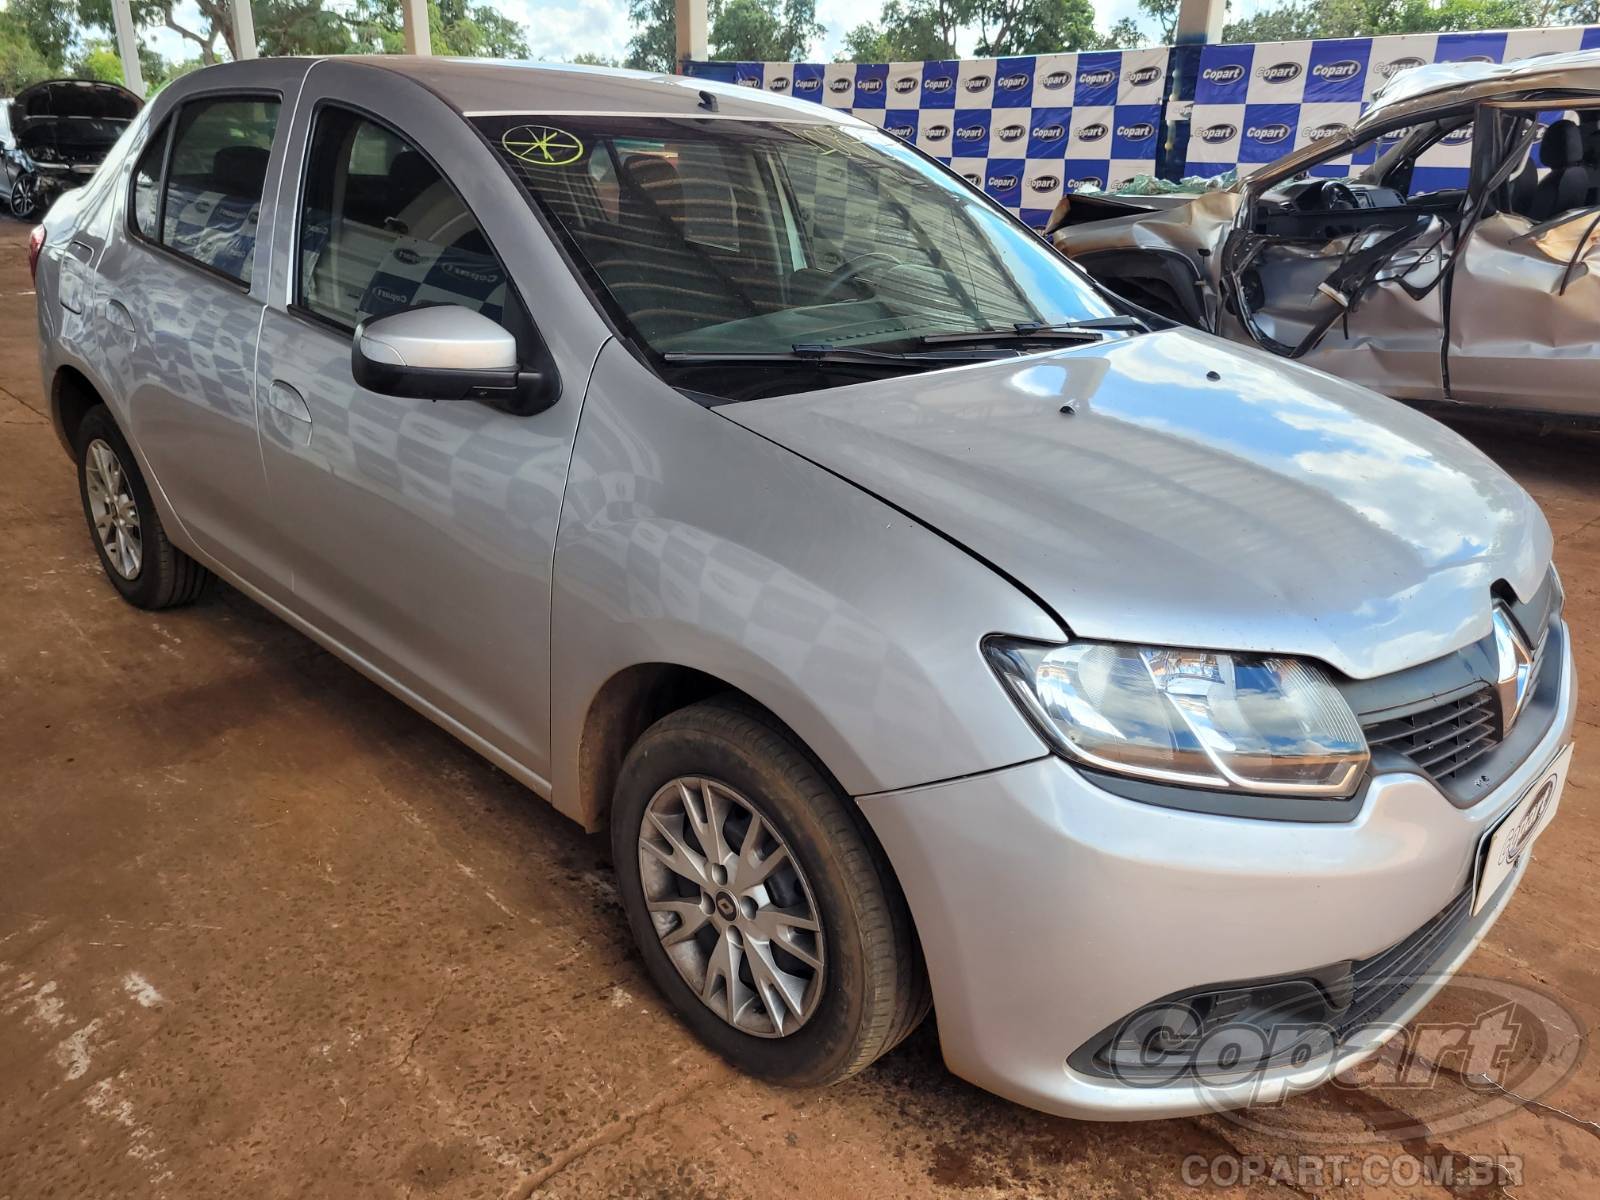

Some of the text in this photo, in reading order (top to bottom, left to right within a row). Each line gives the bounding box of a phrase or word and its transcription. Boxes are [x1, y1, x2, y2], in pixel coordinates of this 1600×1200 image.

[1202, 68, 1241, 81] Copart
[1256, 66, 1296, 79] Copart
[1312, 63, 1355, 78] Copart
[795, 80, 818, 90] Copart
[857, 80, 882, 90] Copart
[924, 79, 950, 90] Copart
[998, 77, 1025, 89] Copart
[1080, 73, 1112, 85] Copart
[956, 127, 982, 138] Copart
[1032, 127, 1061, 139] Copart
[1117, 125, 1151, 138] Copart
[1195, 127, 1232, 140] Copart
[1247, 126, 1286, 140] Copart
[988, 177, 1014, 188] Copart
